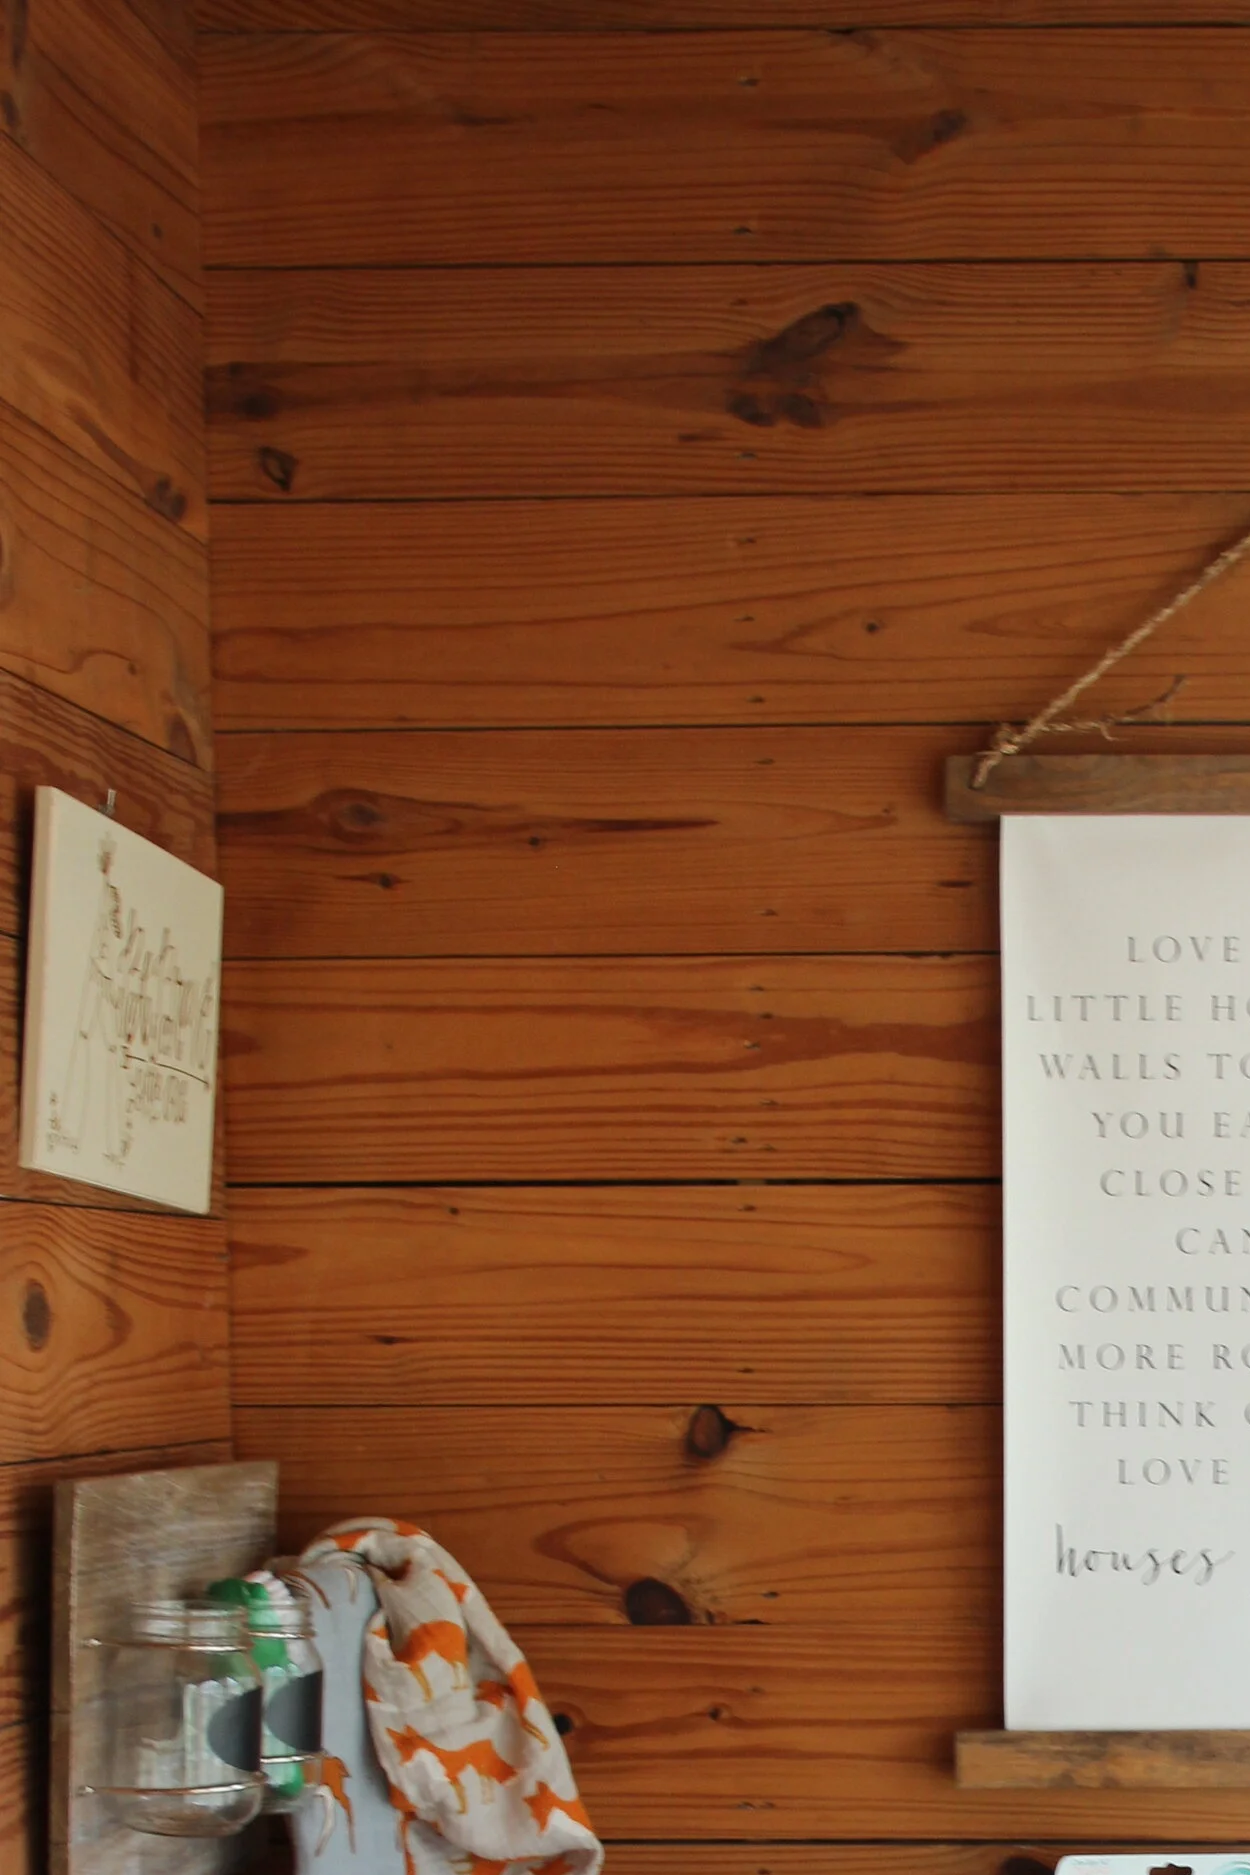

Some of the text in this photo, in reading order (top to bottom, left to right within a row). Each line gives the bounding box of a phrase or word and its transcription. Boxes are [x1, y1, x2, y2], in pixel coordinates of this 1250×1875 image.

[1127, 935, 1240, 964] LOVE
[1027, 994, 1183, 1023] LITTLE
[1039, 1052, 1182, 1081] WALLS
[1091, 1111, 1185, 1139] YOU
[1099, 1169, 1242, 1198] CLOSE
[1058, 1343, 1185, 1371] MORE
[1068, 1400, 1217, 1428] THINK
[1117, 1458, 1229, 1486] LOVE
[1055, 1522, 1235, 1587] houses
